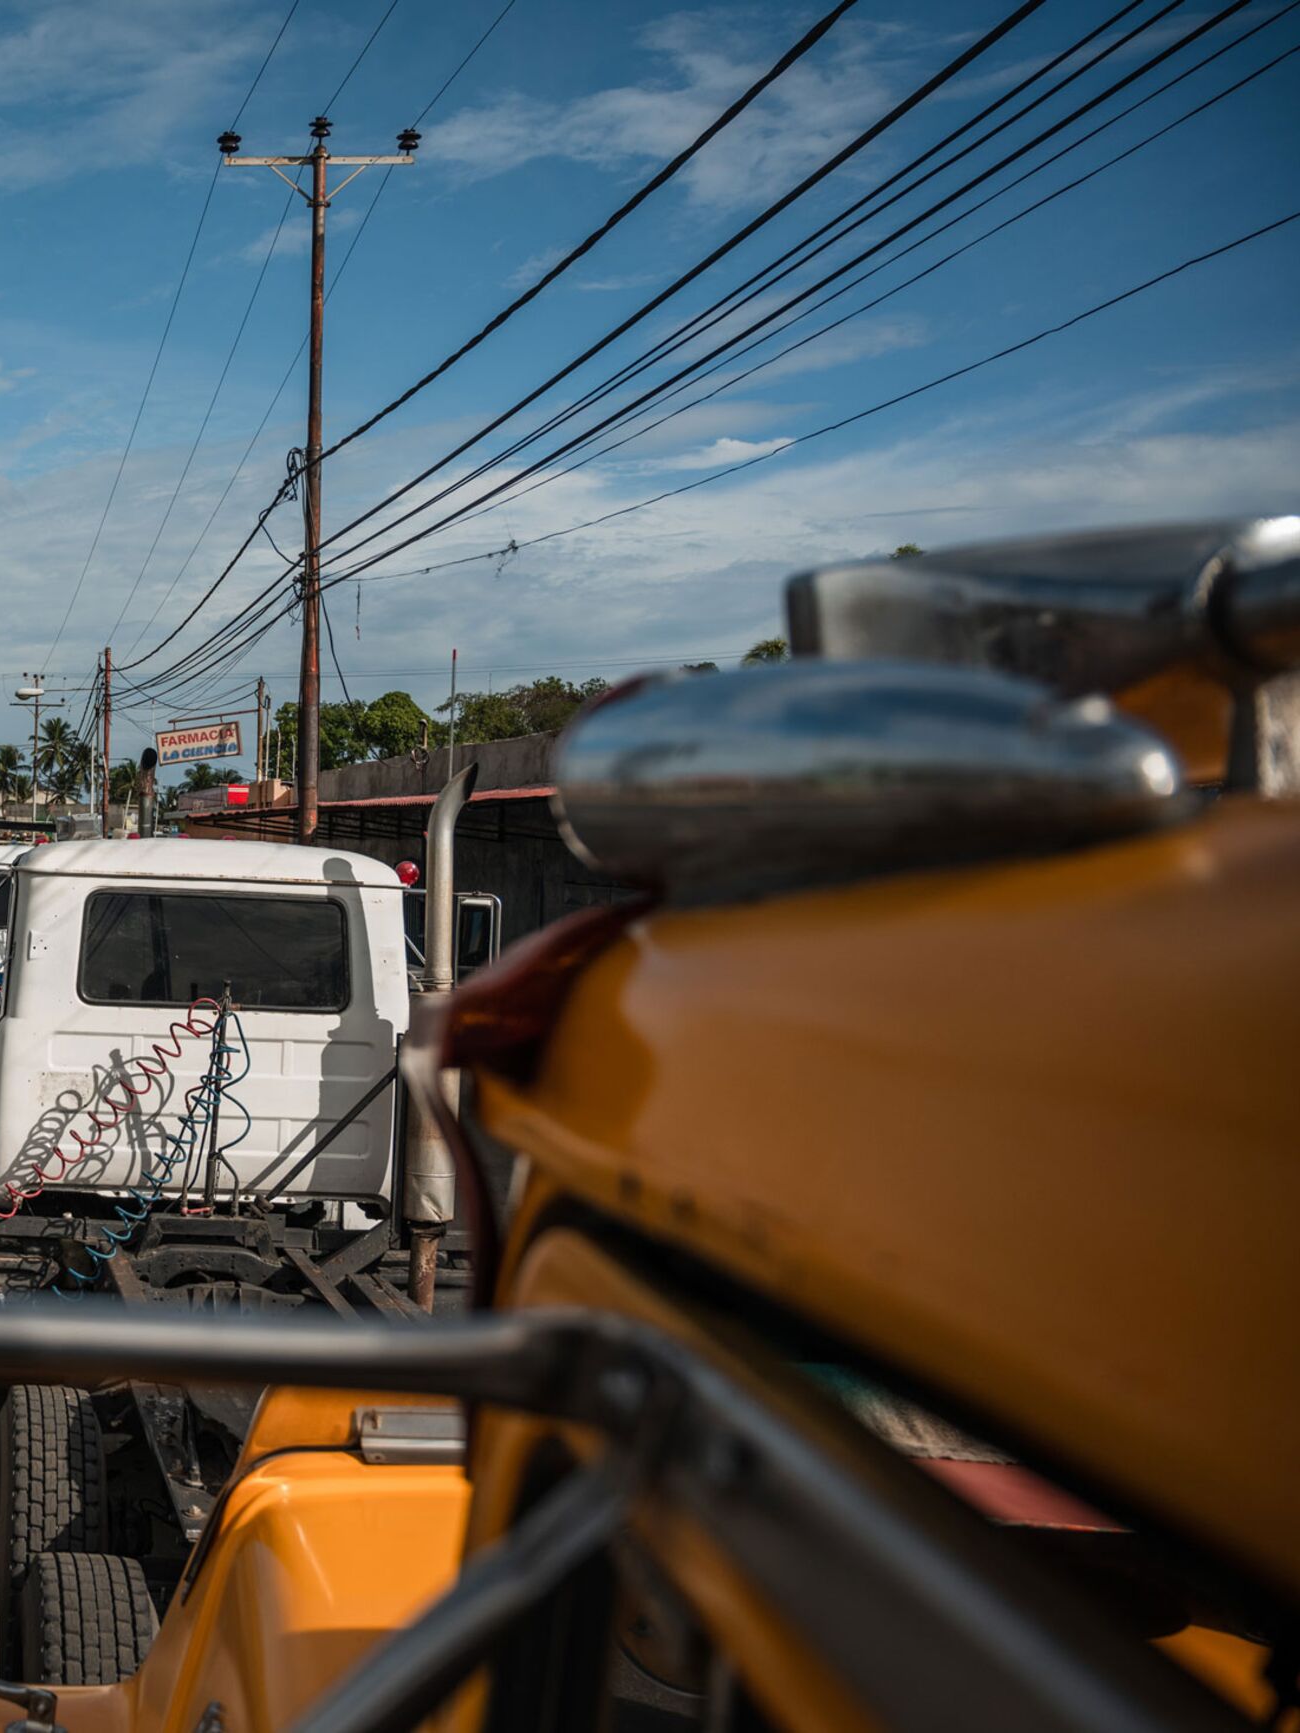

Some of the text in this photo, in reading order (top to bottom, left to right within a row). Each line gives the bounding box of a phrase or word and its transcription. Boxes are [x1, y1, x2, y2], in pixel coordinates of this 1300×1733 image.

[161, 728, 234, 747] FARMACIA
[163, 743, 237, 761] LA CIENCIA
